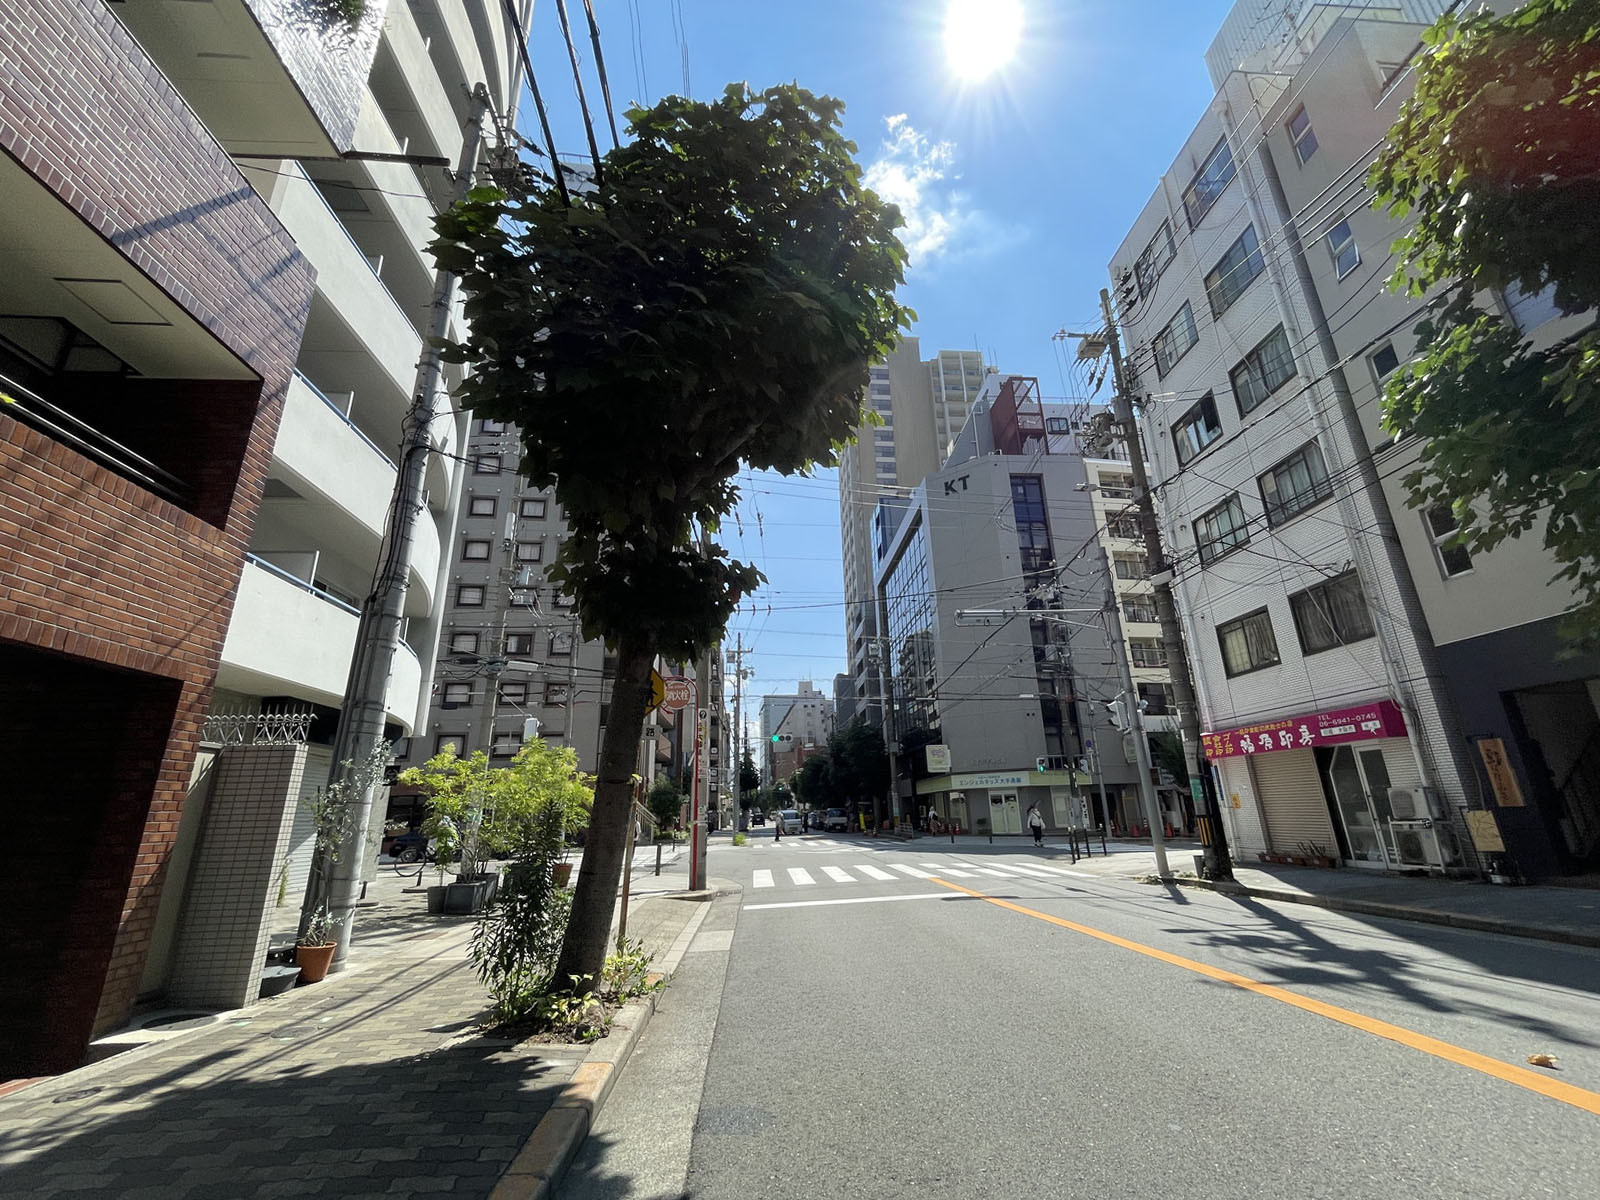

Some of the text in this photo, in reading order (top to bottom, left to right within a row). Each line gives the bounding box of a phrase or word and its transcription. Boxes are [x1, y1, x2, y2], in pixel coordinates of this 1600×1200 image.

[944, 474, 970, 496] KT
[667, 690, 690, 700] 消火栓
